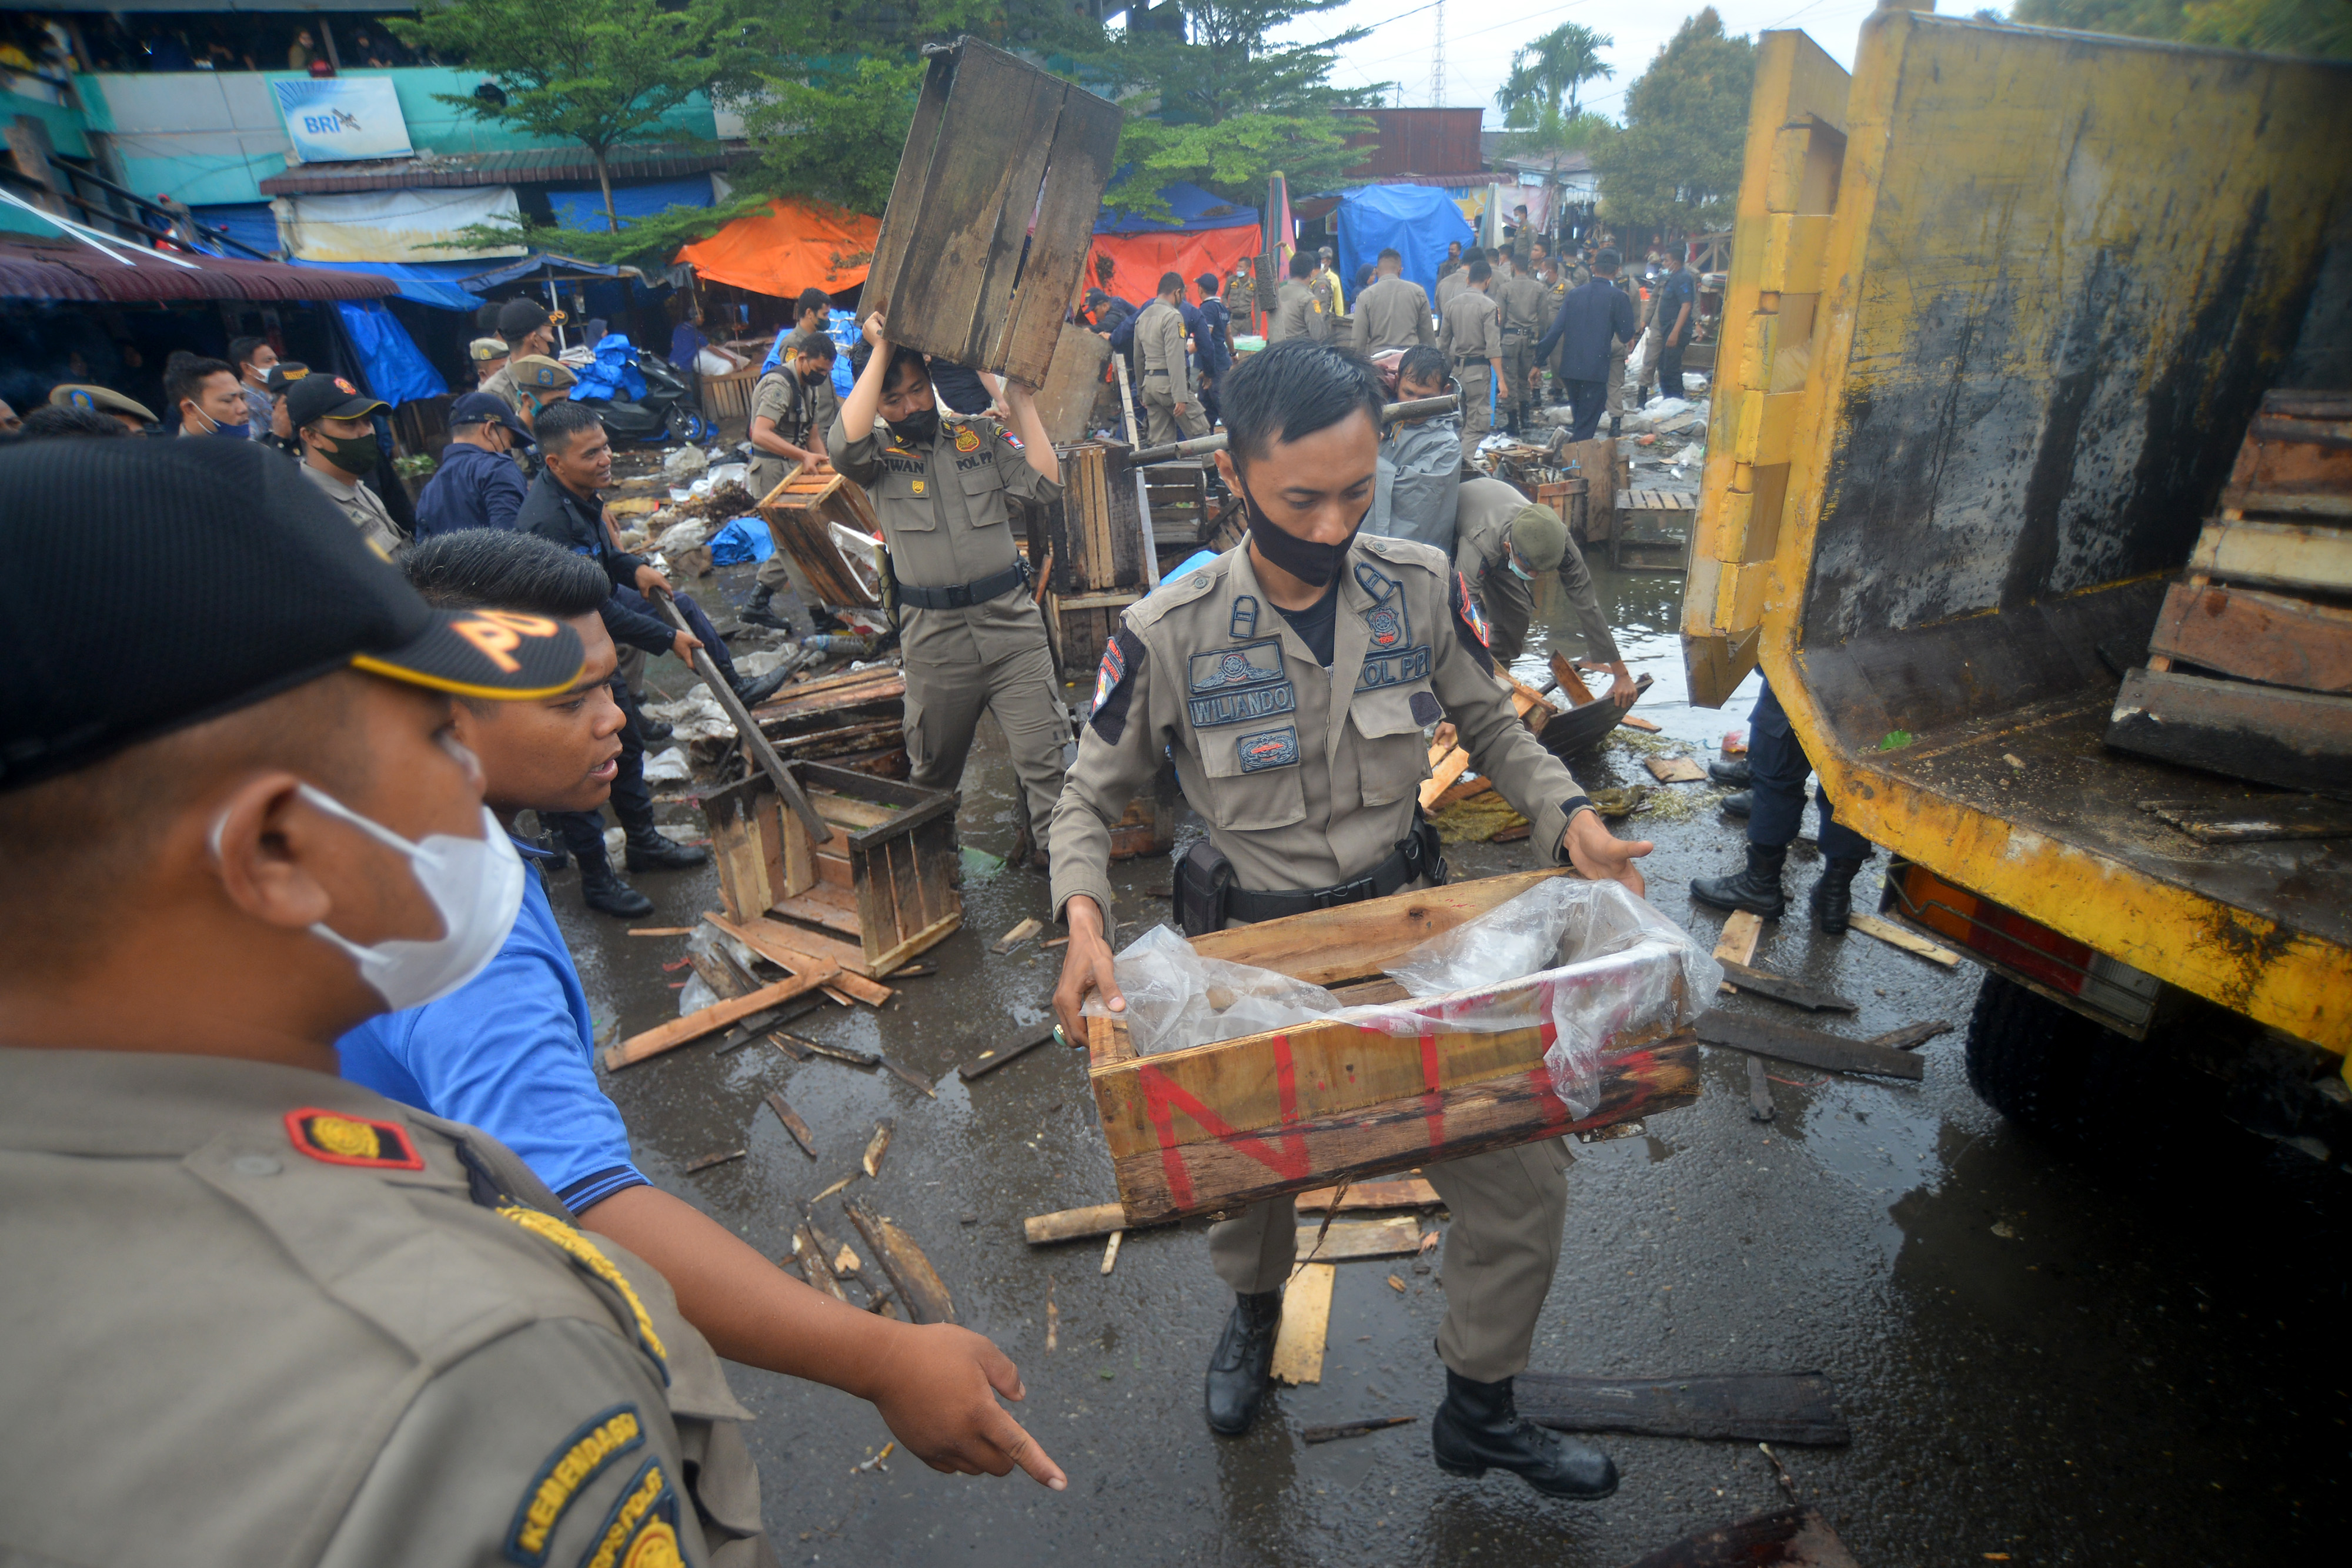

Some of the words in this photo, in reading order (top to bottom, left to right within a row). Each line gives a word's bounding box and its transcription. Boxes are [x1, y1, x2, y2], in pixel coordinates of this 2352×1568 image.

[303, 115, 341, 133] BRI
[956, 456, 980, 471] POL
[978, 451, 993, 464] PP
[1378, 636, 1394, 644] 1950
[1358, 660, 1396, 686] OL
[1401, 653, 1426, 680] PP
